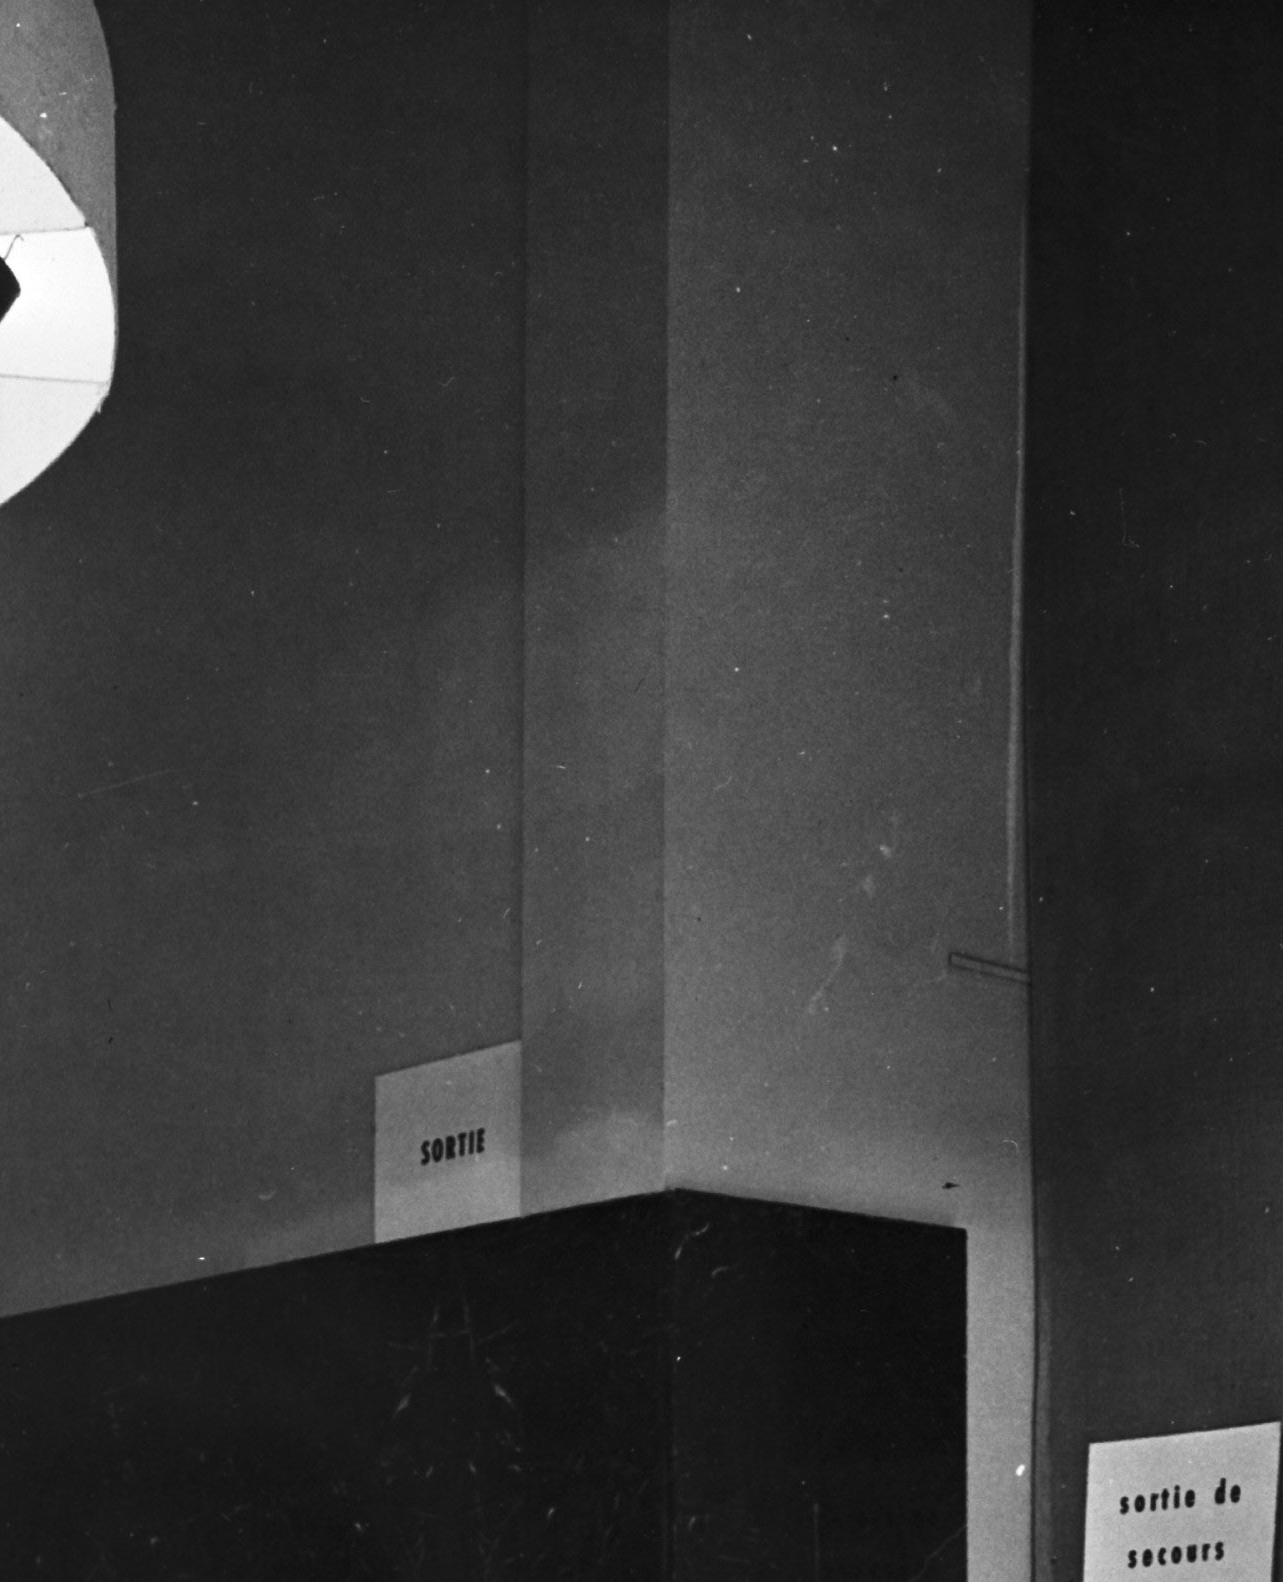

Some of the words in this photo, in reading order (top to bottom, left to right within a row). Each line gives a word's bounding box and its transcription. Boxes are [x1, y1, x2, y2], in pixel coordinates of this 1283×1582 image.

[420, 1127, 486, 1166] SORTIE
[1119, 1484, 1196, 1515] sortie
[1214, 1477, 1242, 1505] de
[1127, 1541, 1225, 1569] secours
